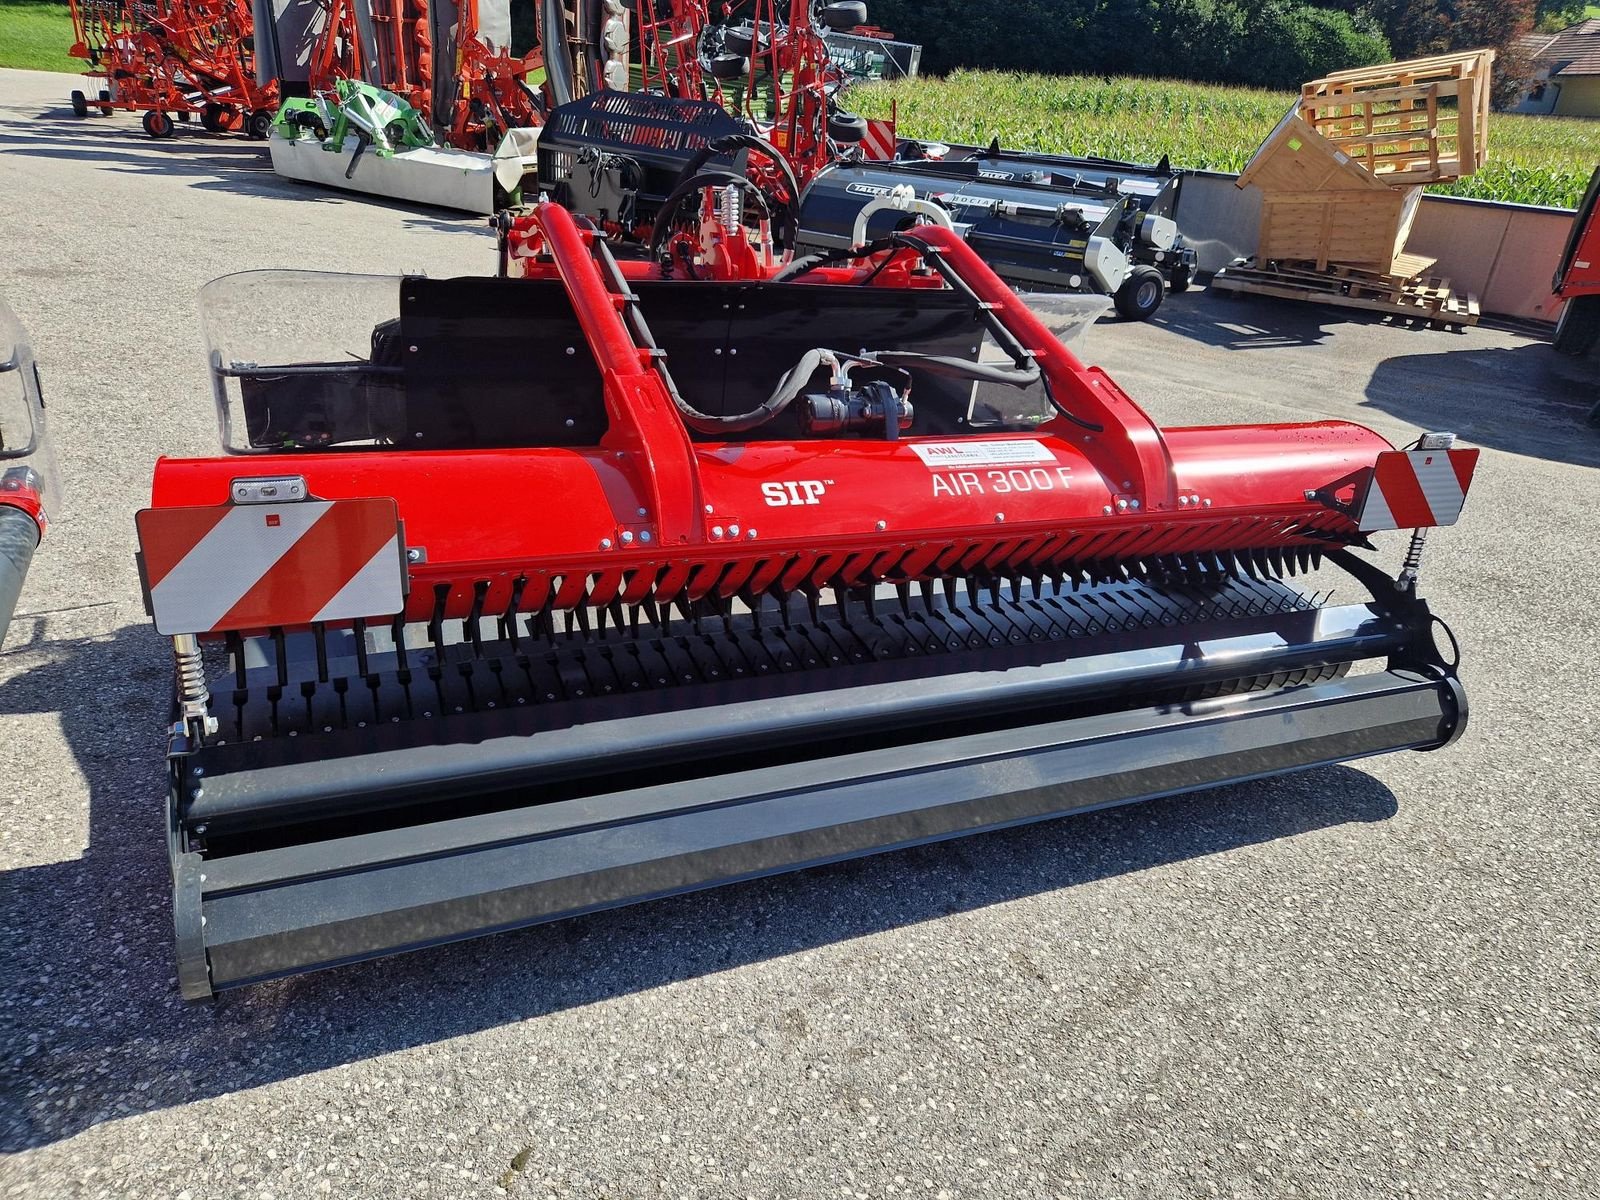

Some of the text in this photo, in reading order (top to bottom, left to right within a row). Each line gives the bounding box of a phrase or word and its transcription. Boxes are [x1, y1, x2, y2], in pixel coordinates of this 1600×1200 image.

[927, 446, 964, 455] AWL
[932, 467, 1075, 497] AIR 300 F
